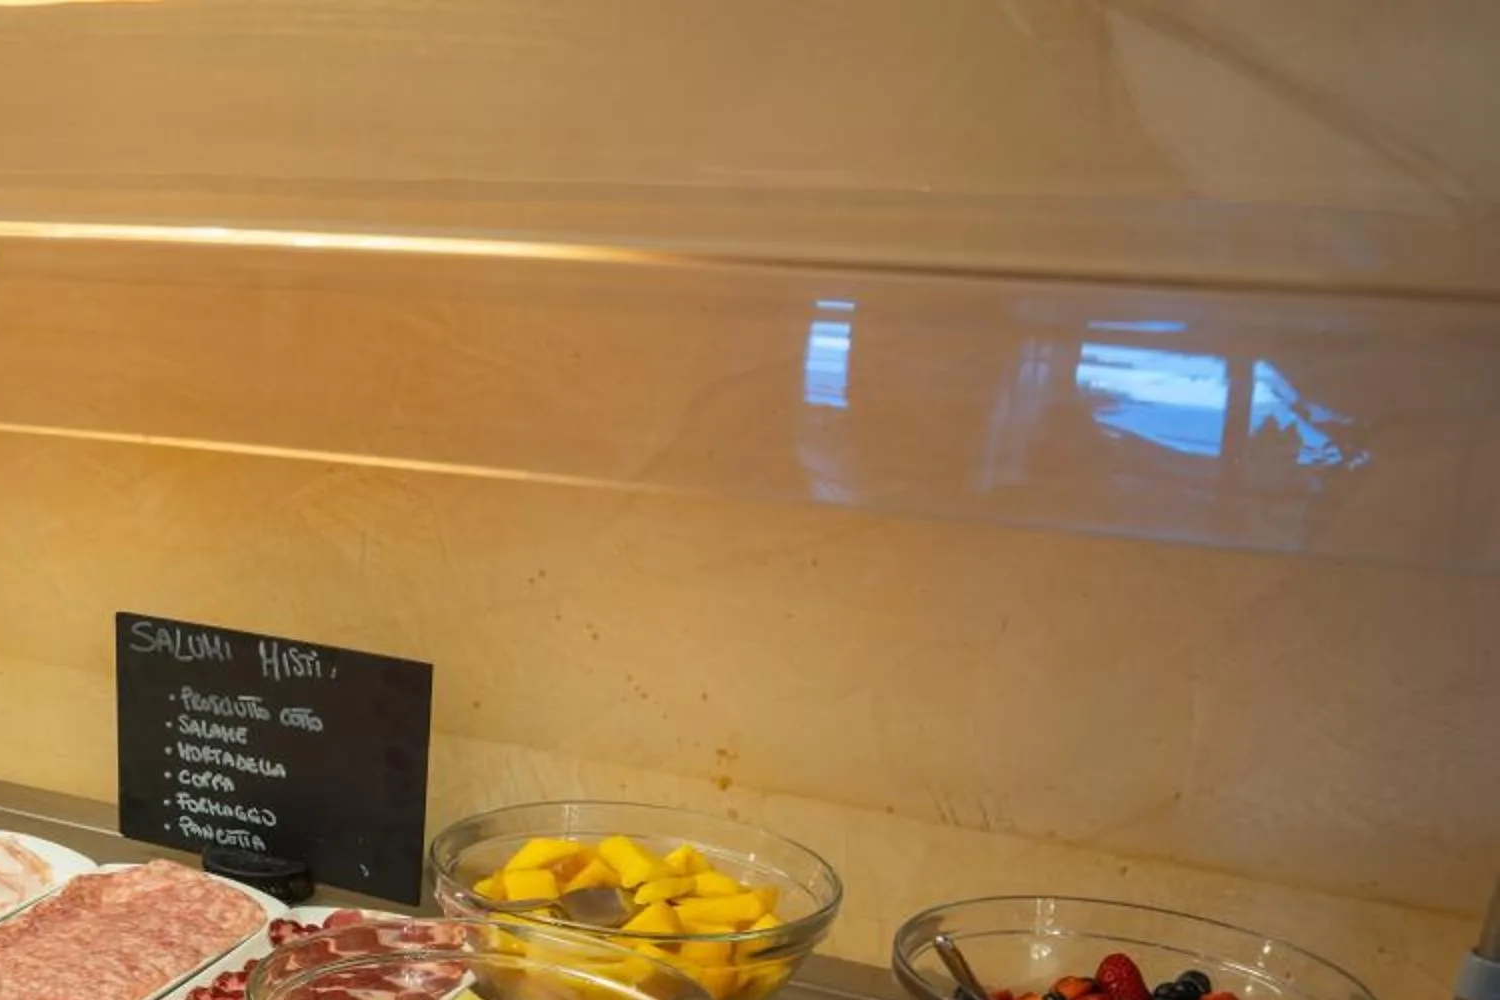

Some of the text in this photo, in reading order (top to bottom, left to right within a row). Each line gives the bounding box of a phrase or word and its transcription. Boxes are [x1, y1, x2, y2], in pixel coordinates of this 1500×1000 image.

[131, 621, 233, 663] SALUMI
[177, 714, 248, 745] SALAME
[279, 707, 324, 732] COTTO
[177, 741, 287, 779] MORTADELLA
[177, 769, 235, 792] COPPA
[178, 815, 267, 852] PANCETTA
